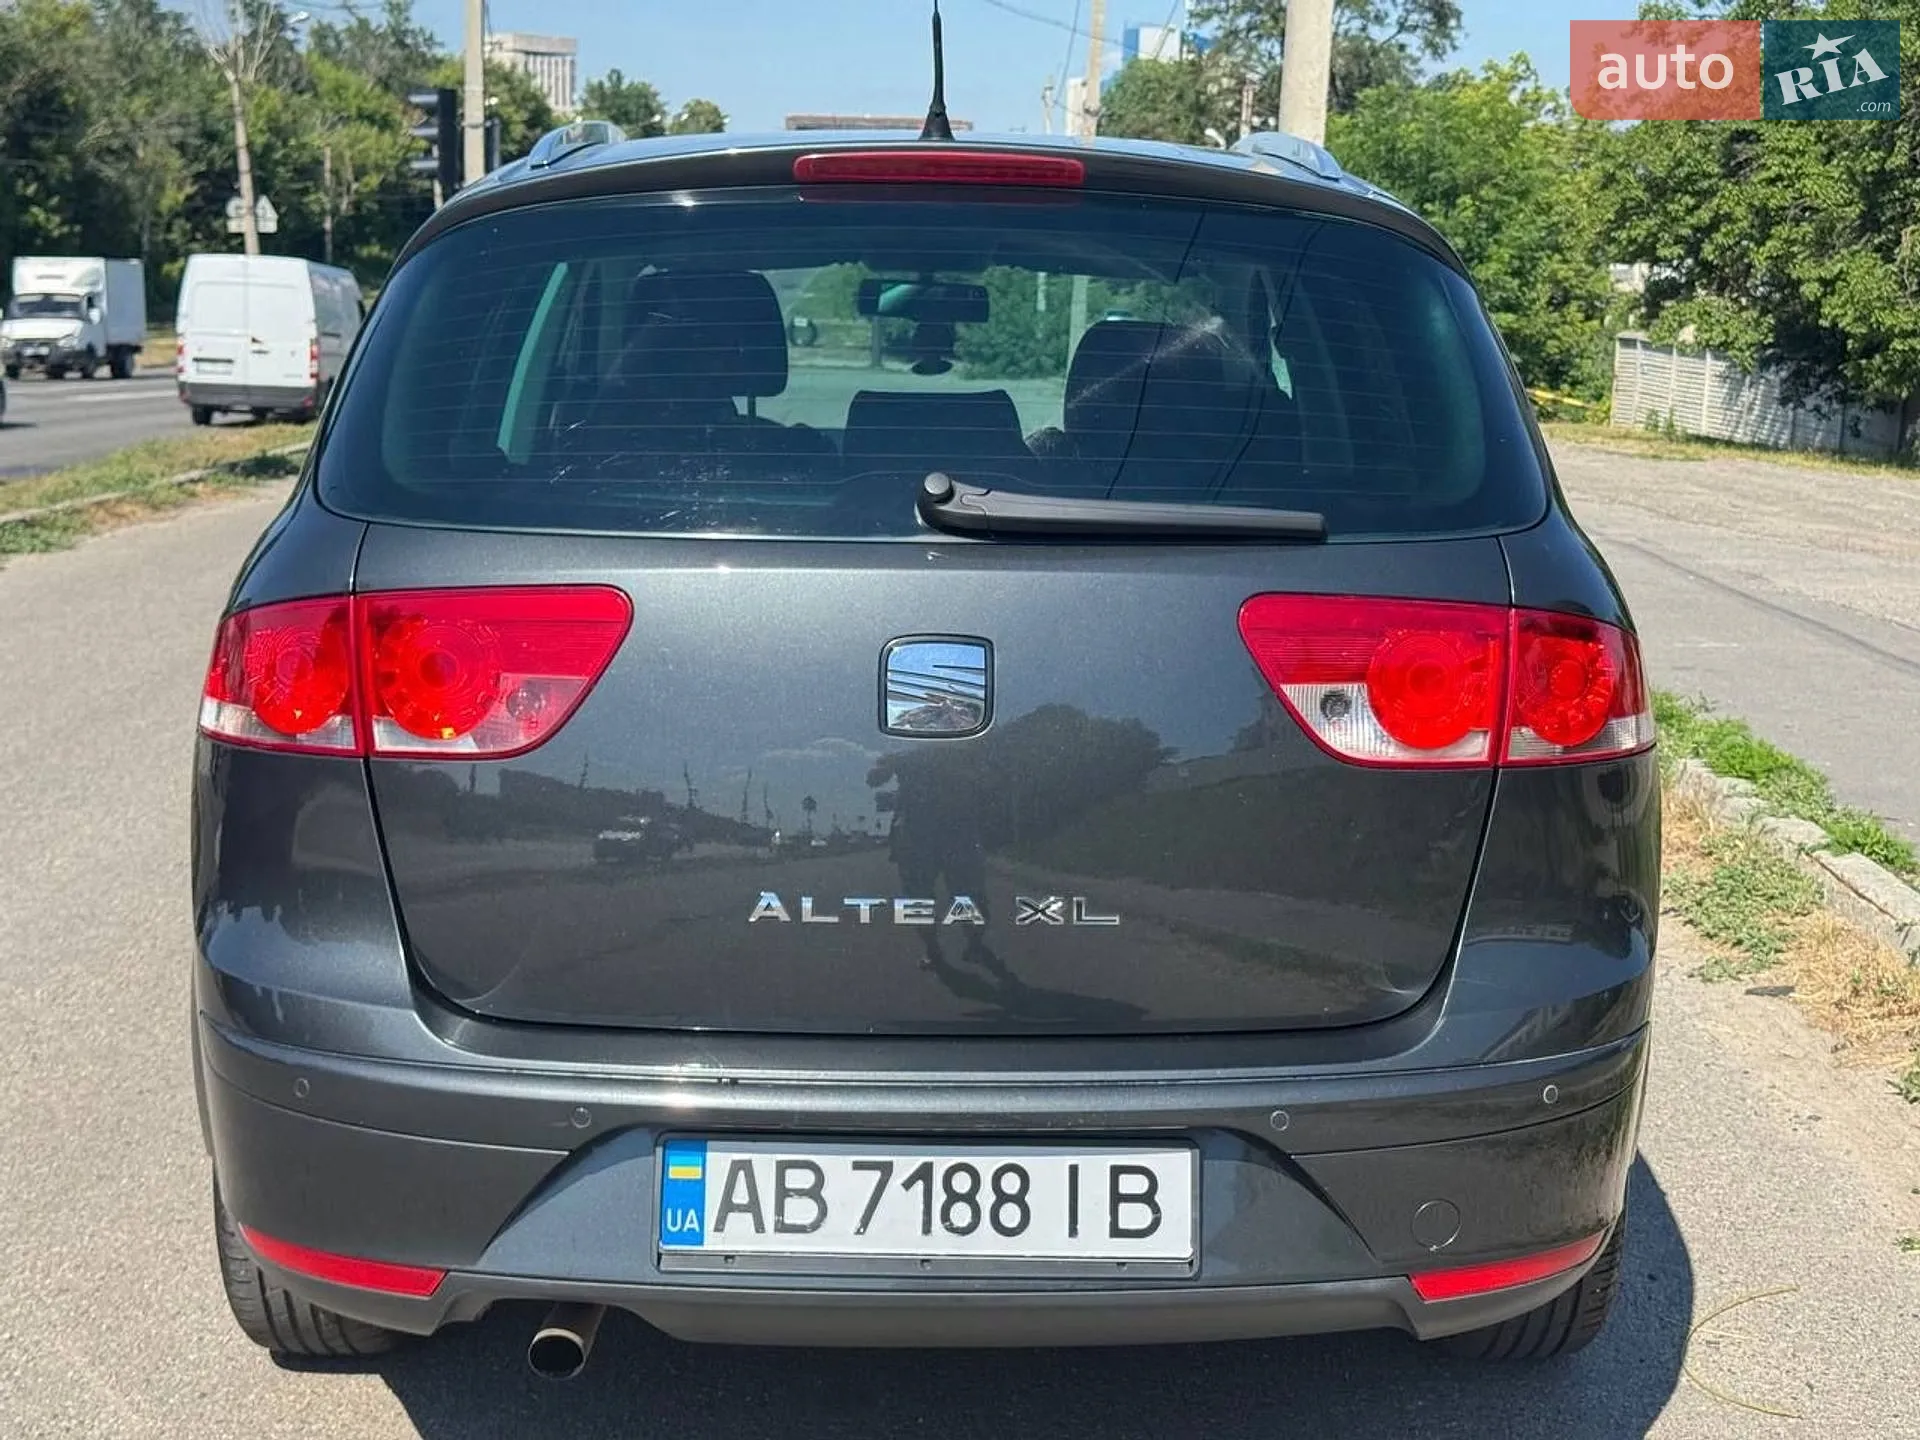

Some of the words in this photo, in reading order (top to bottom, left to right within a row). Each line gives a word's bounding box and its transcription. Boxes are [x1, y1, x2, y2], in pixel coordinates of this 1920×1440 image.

[748, 891, 985, 925] ALTEA
[1015, 896, 1120, 925] XL
[713, 1158, 828, 1234] AB
[851, 1160, 1031, 1238] 7188
[1067, 1163, 1162, 1239] IB
[666, 1209, 700, 1232] UA
